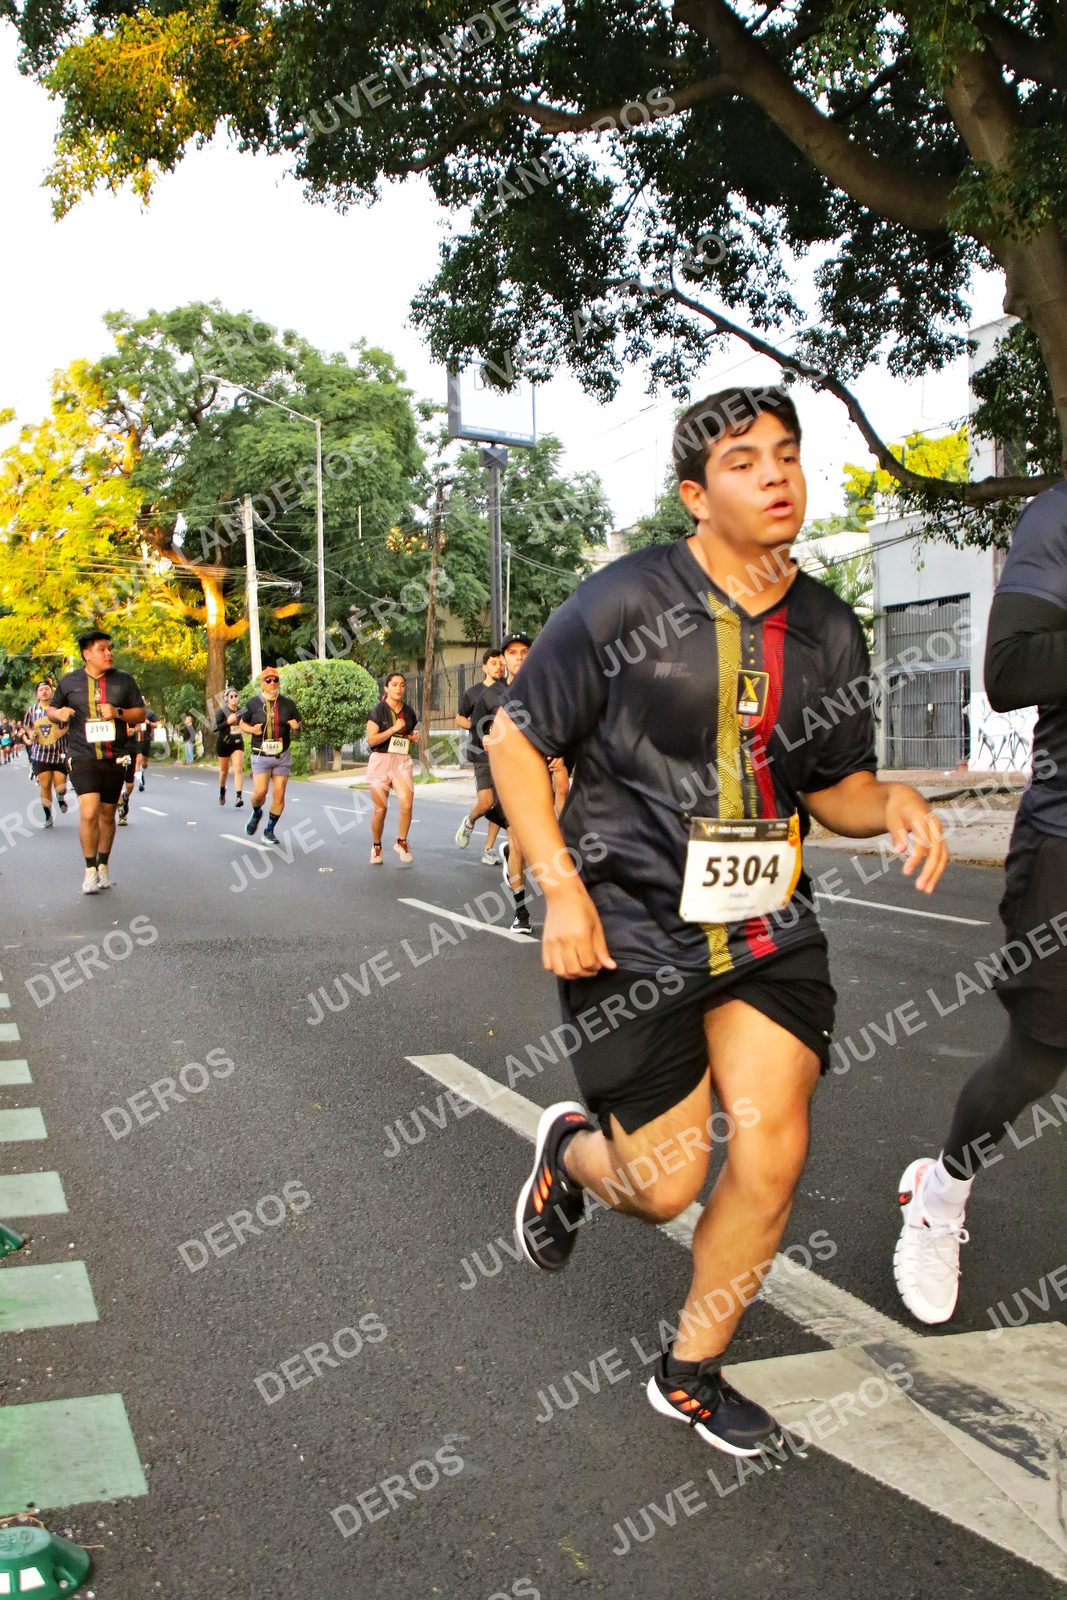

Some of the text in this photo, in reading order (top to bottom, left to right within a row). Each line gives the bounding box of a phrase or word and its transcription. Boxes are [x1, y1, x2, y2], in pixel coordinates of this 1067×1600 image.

[90, 724, 109, 734] 2191
[393, 739, 406, 747] 6061
[702, 854, 780, 887] 5304
